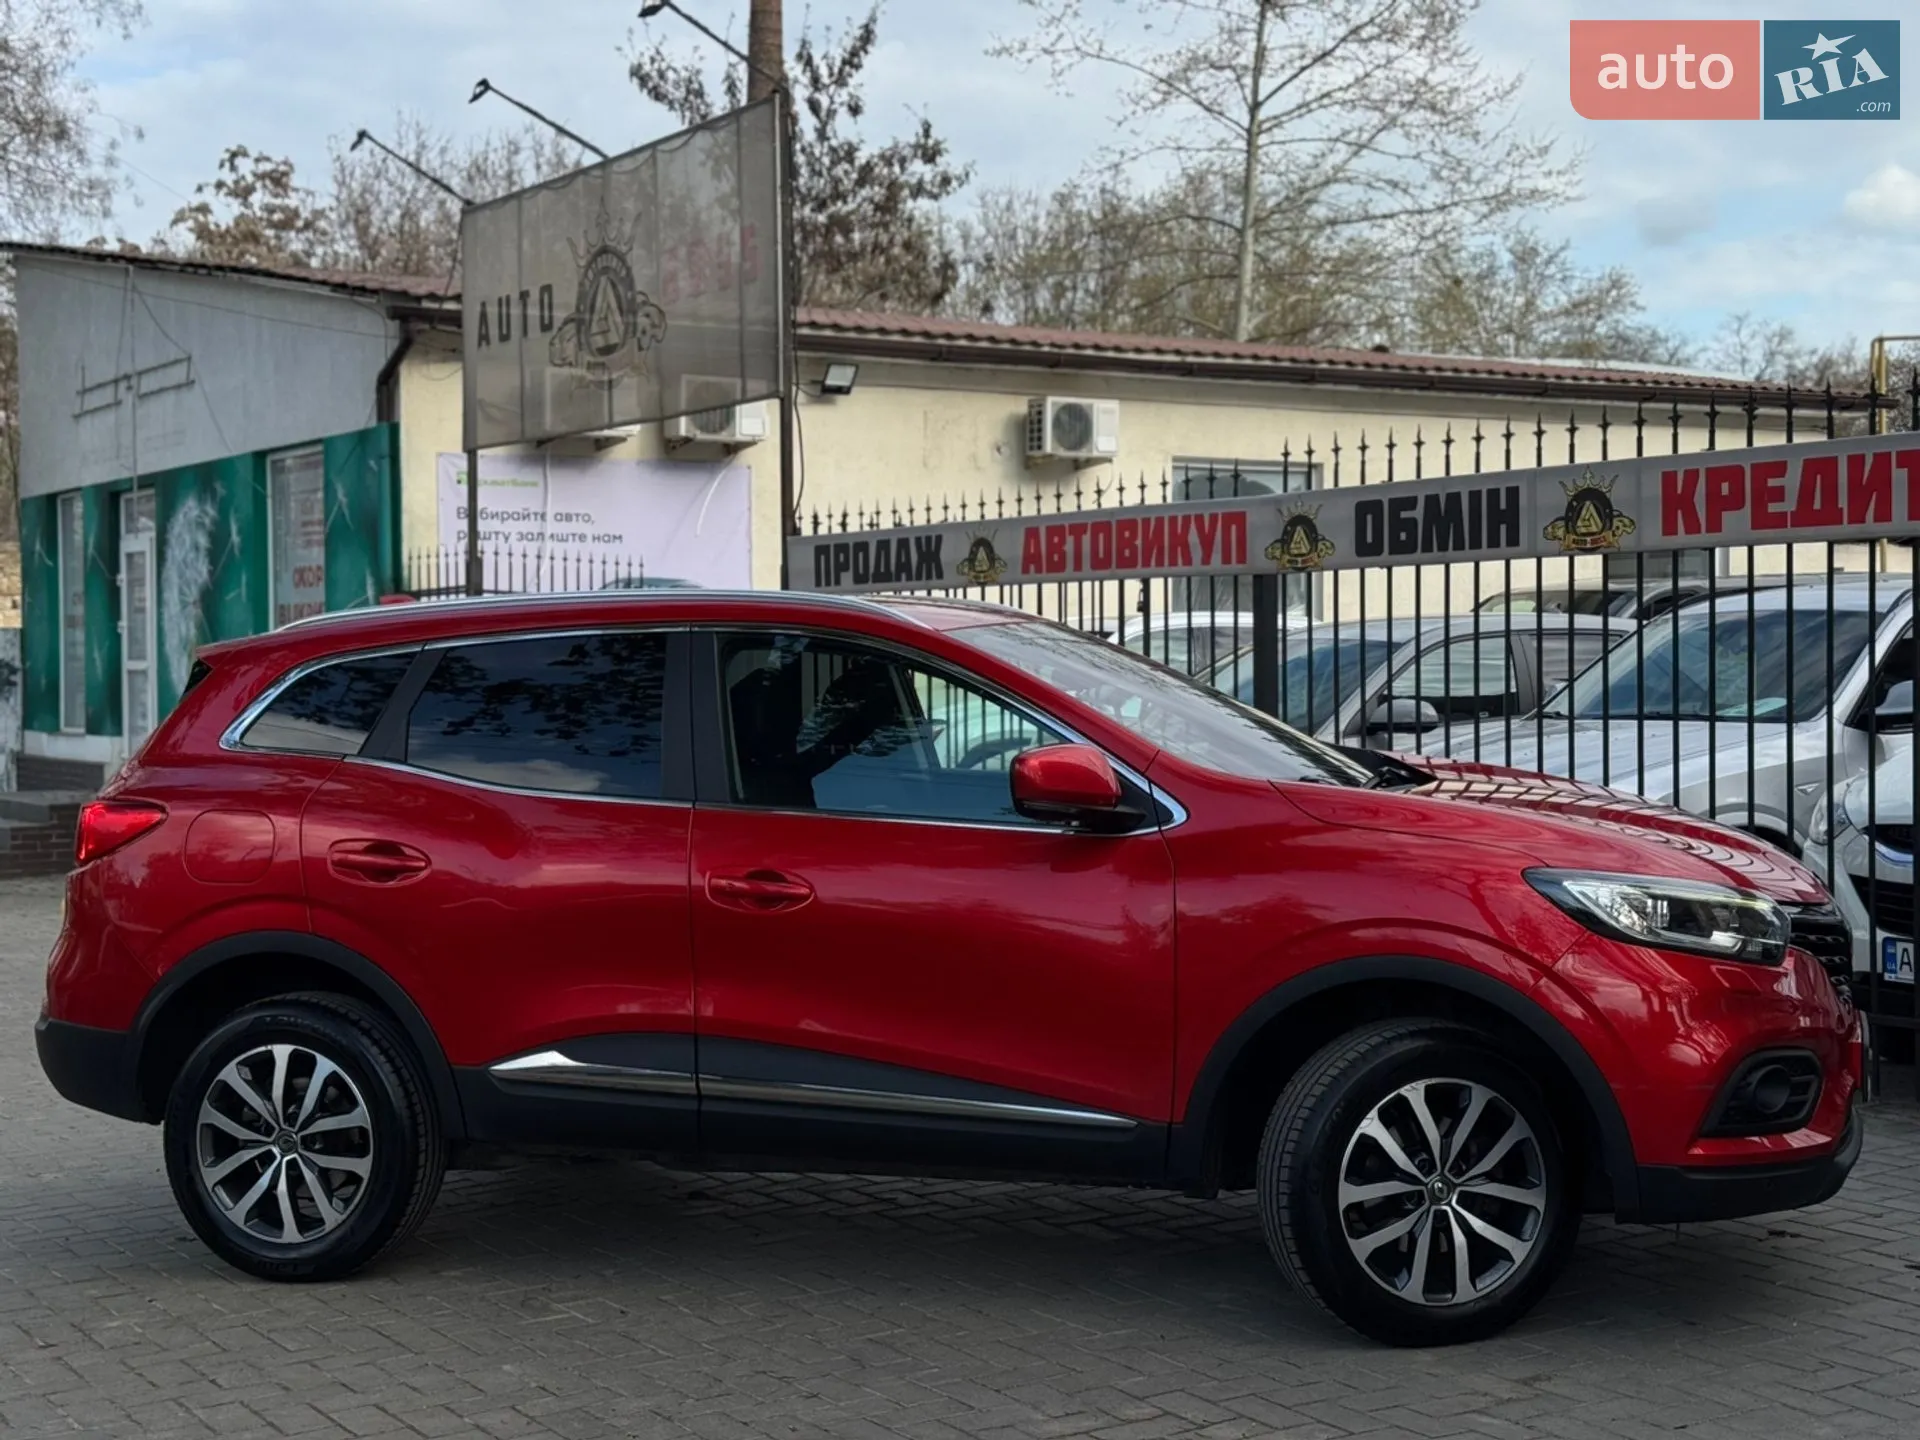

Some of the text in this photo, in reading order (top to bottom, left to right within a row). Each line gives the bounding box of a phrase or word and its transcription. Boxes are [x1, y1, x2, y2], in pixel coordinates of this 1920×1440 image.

[478, 283, 554, 349] AUTO
[457, 506, 595, 525] Вбирайте авто,
[457, 529, 510, 543] ршту
[592, 533, 623, 543] нам
[814, 449, 1920, 587] ПРОДАЖ АВТОВИКУП ОБМІН КРЕДИТ
